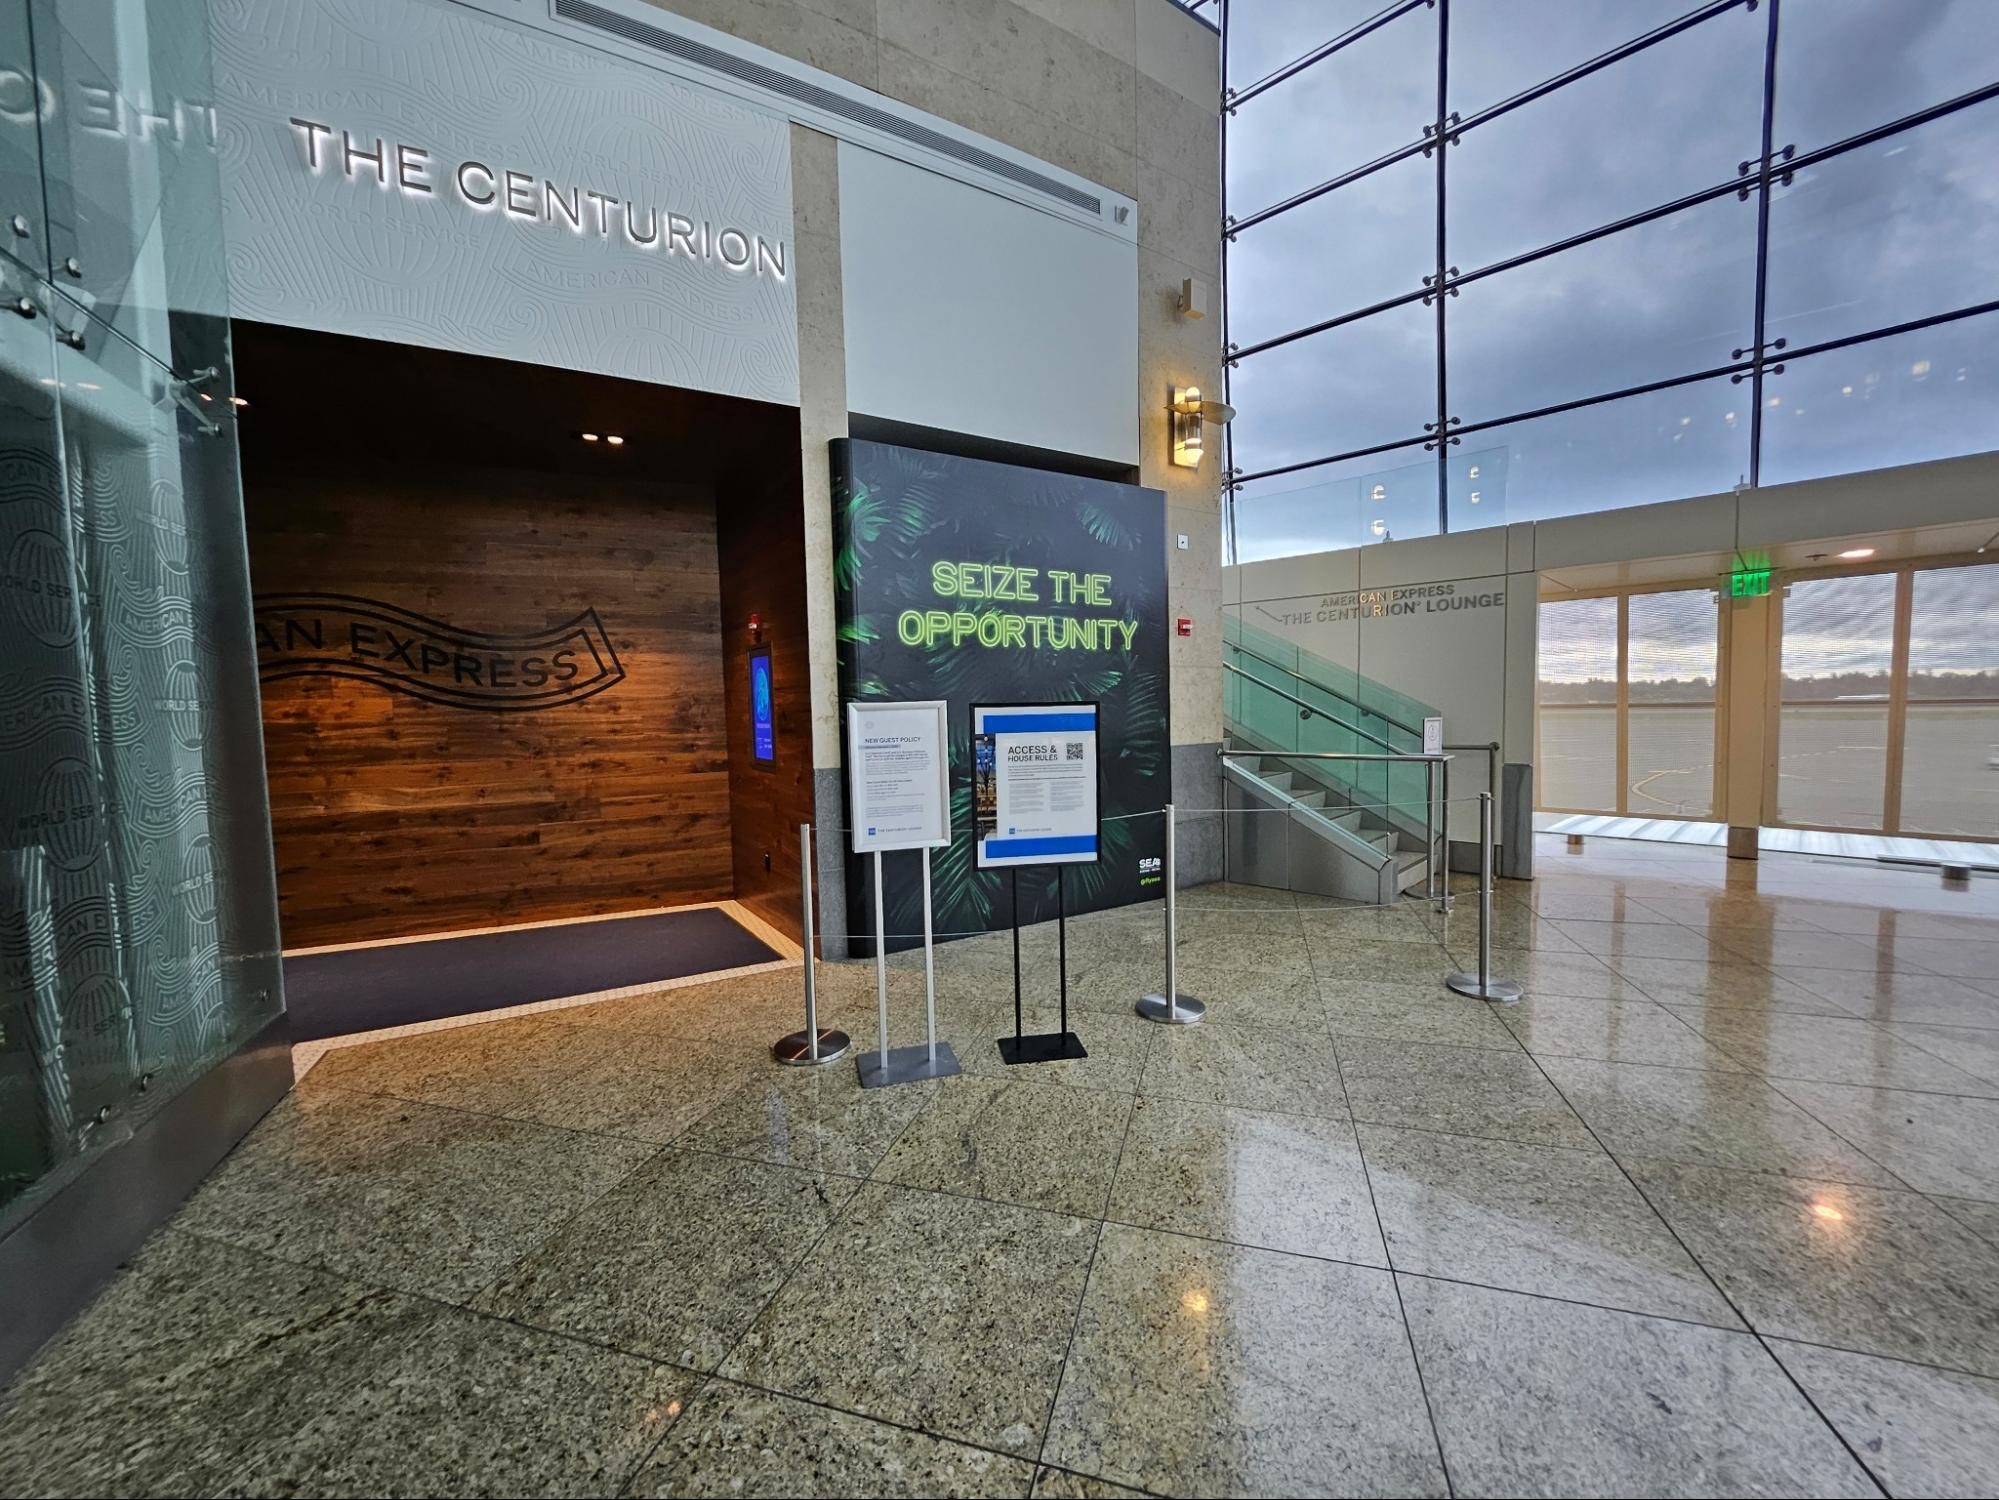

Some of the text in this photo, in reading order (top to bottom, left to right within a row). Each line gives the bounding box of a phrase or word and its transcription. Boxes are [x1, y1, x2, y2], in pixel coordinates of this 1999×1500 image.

[289, 116, 787, 278] THE CENTURION
[932, 560, 1112, 606] SEIZE THE
[1321, 584, 1455, 608] AMERICAN EXPRESS
[1732, 572, 1770, 596] EXIT
[1282, 610, 1312, 626] THE
[1426, 593, 1505, 612] LOUNGE
[898, 610, 1138, 650] OPPORTUNITY
[350, 622, 578, 688] EXPRESS
[1007, 753, 1058, 762] HOUSE RULES
[1008, 745, 1057, 754] ACCESS &
